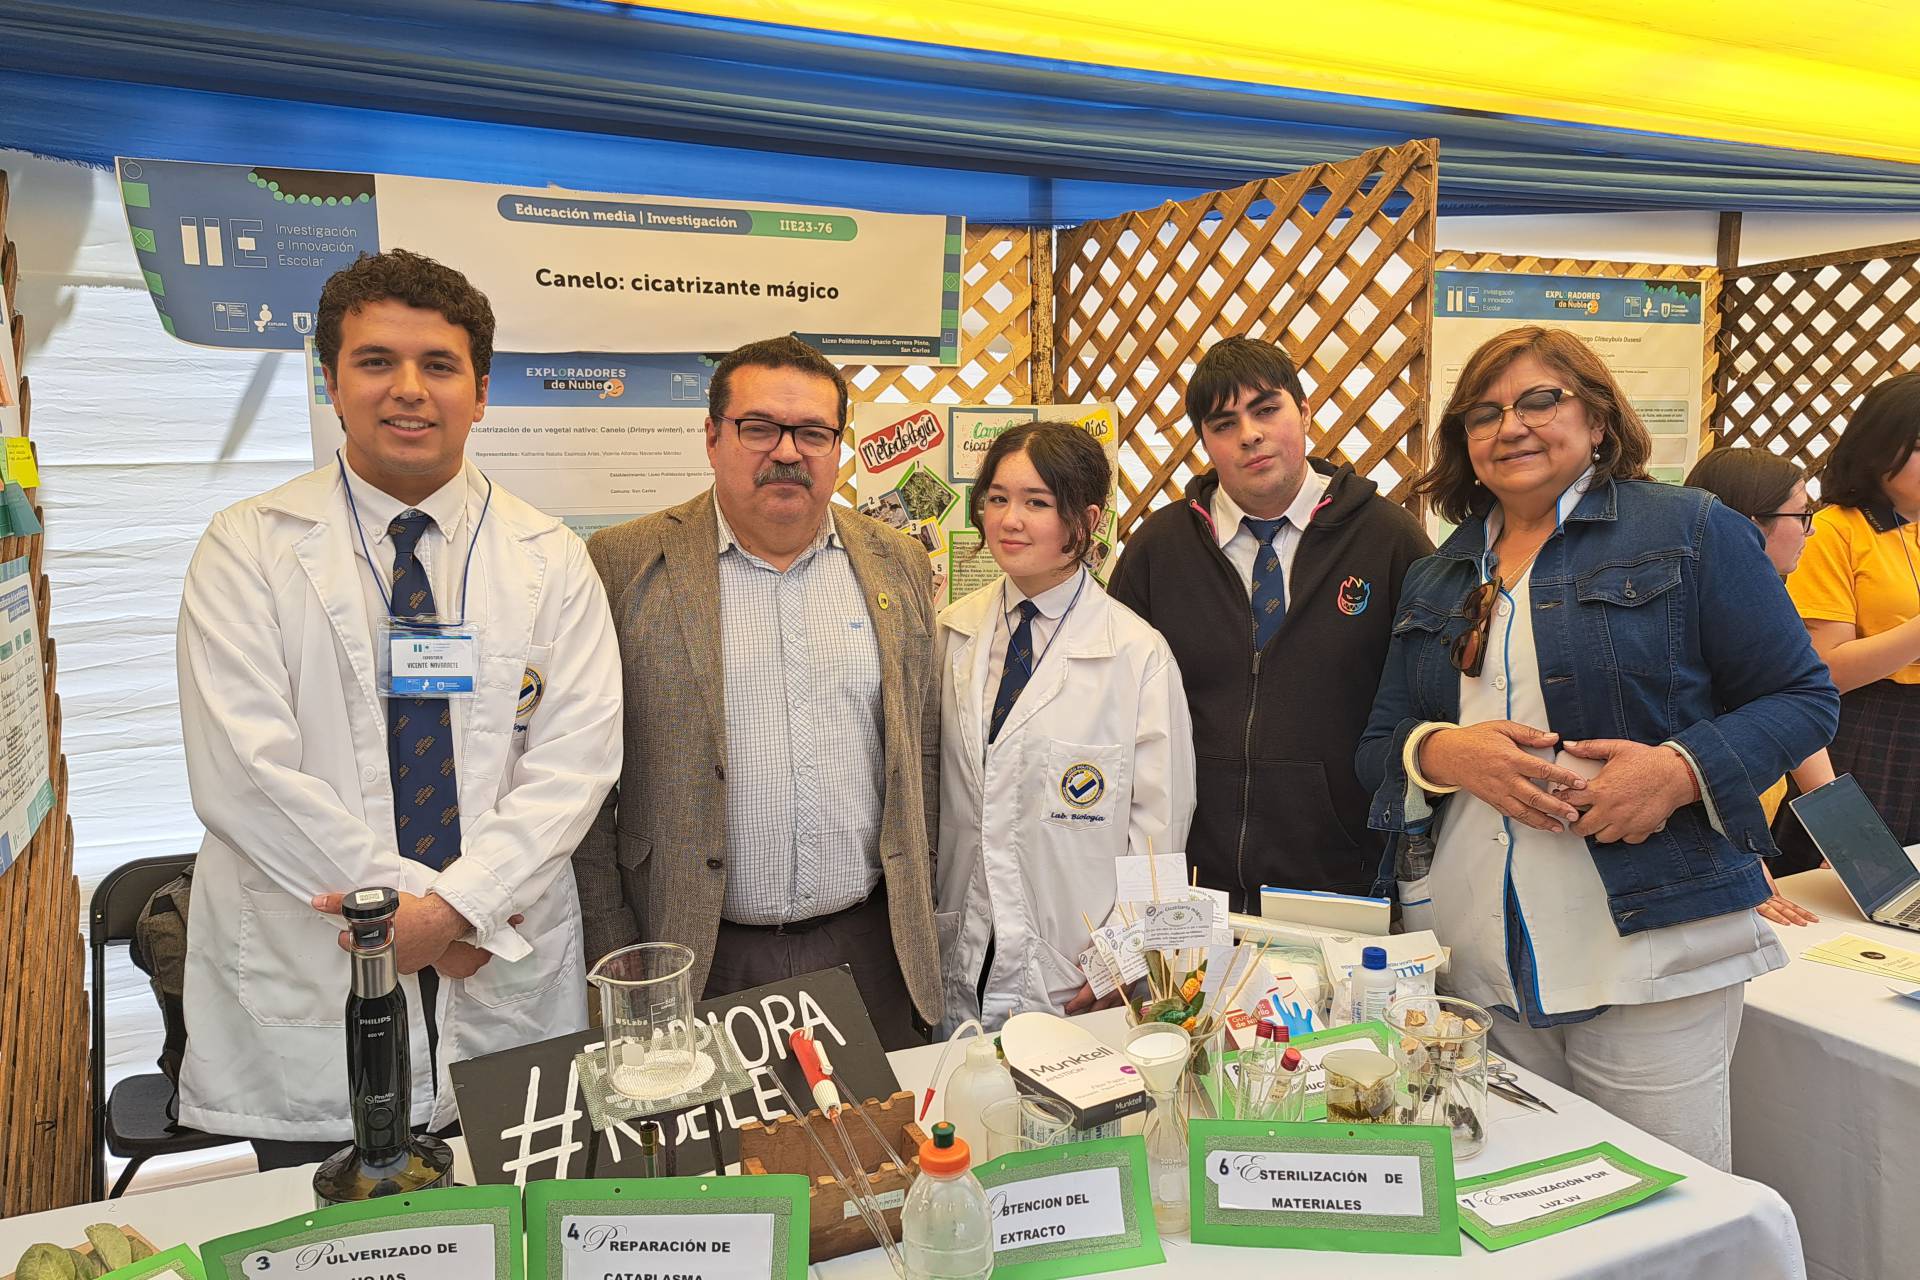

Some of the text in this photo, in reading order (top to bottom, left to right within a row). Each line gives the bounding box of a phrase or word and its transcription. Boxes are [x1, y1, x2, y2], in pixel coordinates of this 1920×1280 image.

[514, 203, 590, 220] Educación
[593, 210, 636, 223] media
[648, 212, 738, 228] Investigación
[276, 224, 357, 238] Investigación
[779, 220, 832, 234] IIE23-76
[278, 240, 354, 252] e Innovación
[278, 254, 324, 267] Escolar
[535, 268, 839, 302] Canelo: cicatrizante mágico
[526, 368, 626, 378] EXPLORADORES
[552, 378, 602, 390] de Ñuble
[545, 426, 572, 434] vegetal
[972, 419, 1013, 440] Canel
[964, 438, 993, 452] cicat
[868, 496, 874, 505] 2
[911, 523, 917, 532] 3
[937, 564, 942, 572] 5
[1050, 812, 1067, 820] Lab.
[360, 1016, 392, 1026] PHILIPS
[1028, 1046, 1114, 1077] Munktell
[1114, 1096, 1142, 1112] Munktell
[1219, 1154, 1403, 1184] 6 ESTERILIZACIÓN DE
[1472, 1178, 1583, 1206] ESTERILIZACIÓN
[1586, 1170, 1609, 1182] POR
[1066, 1194, 1089, 1206] DEL
[1272, 1198, 1362, 1211] MATERIALES
[1540, 1194, 1582, 1210] LUZ UV
[567, 1222, 730, 1252] 4 PREPARACIÓN DE
[1000, 1224, 1066, 1244] EXTRACTO
[256, 1240, 458, 1272] 3 PULVERIZADO DE
